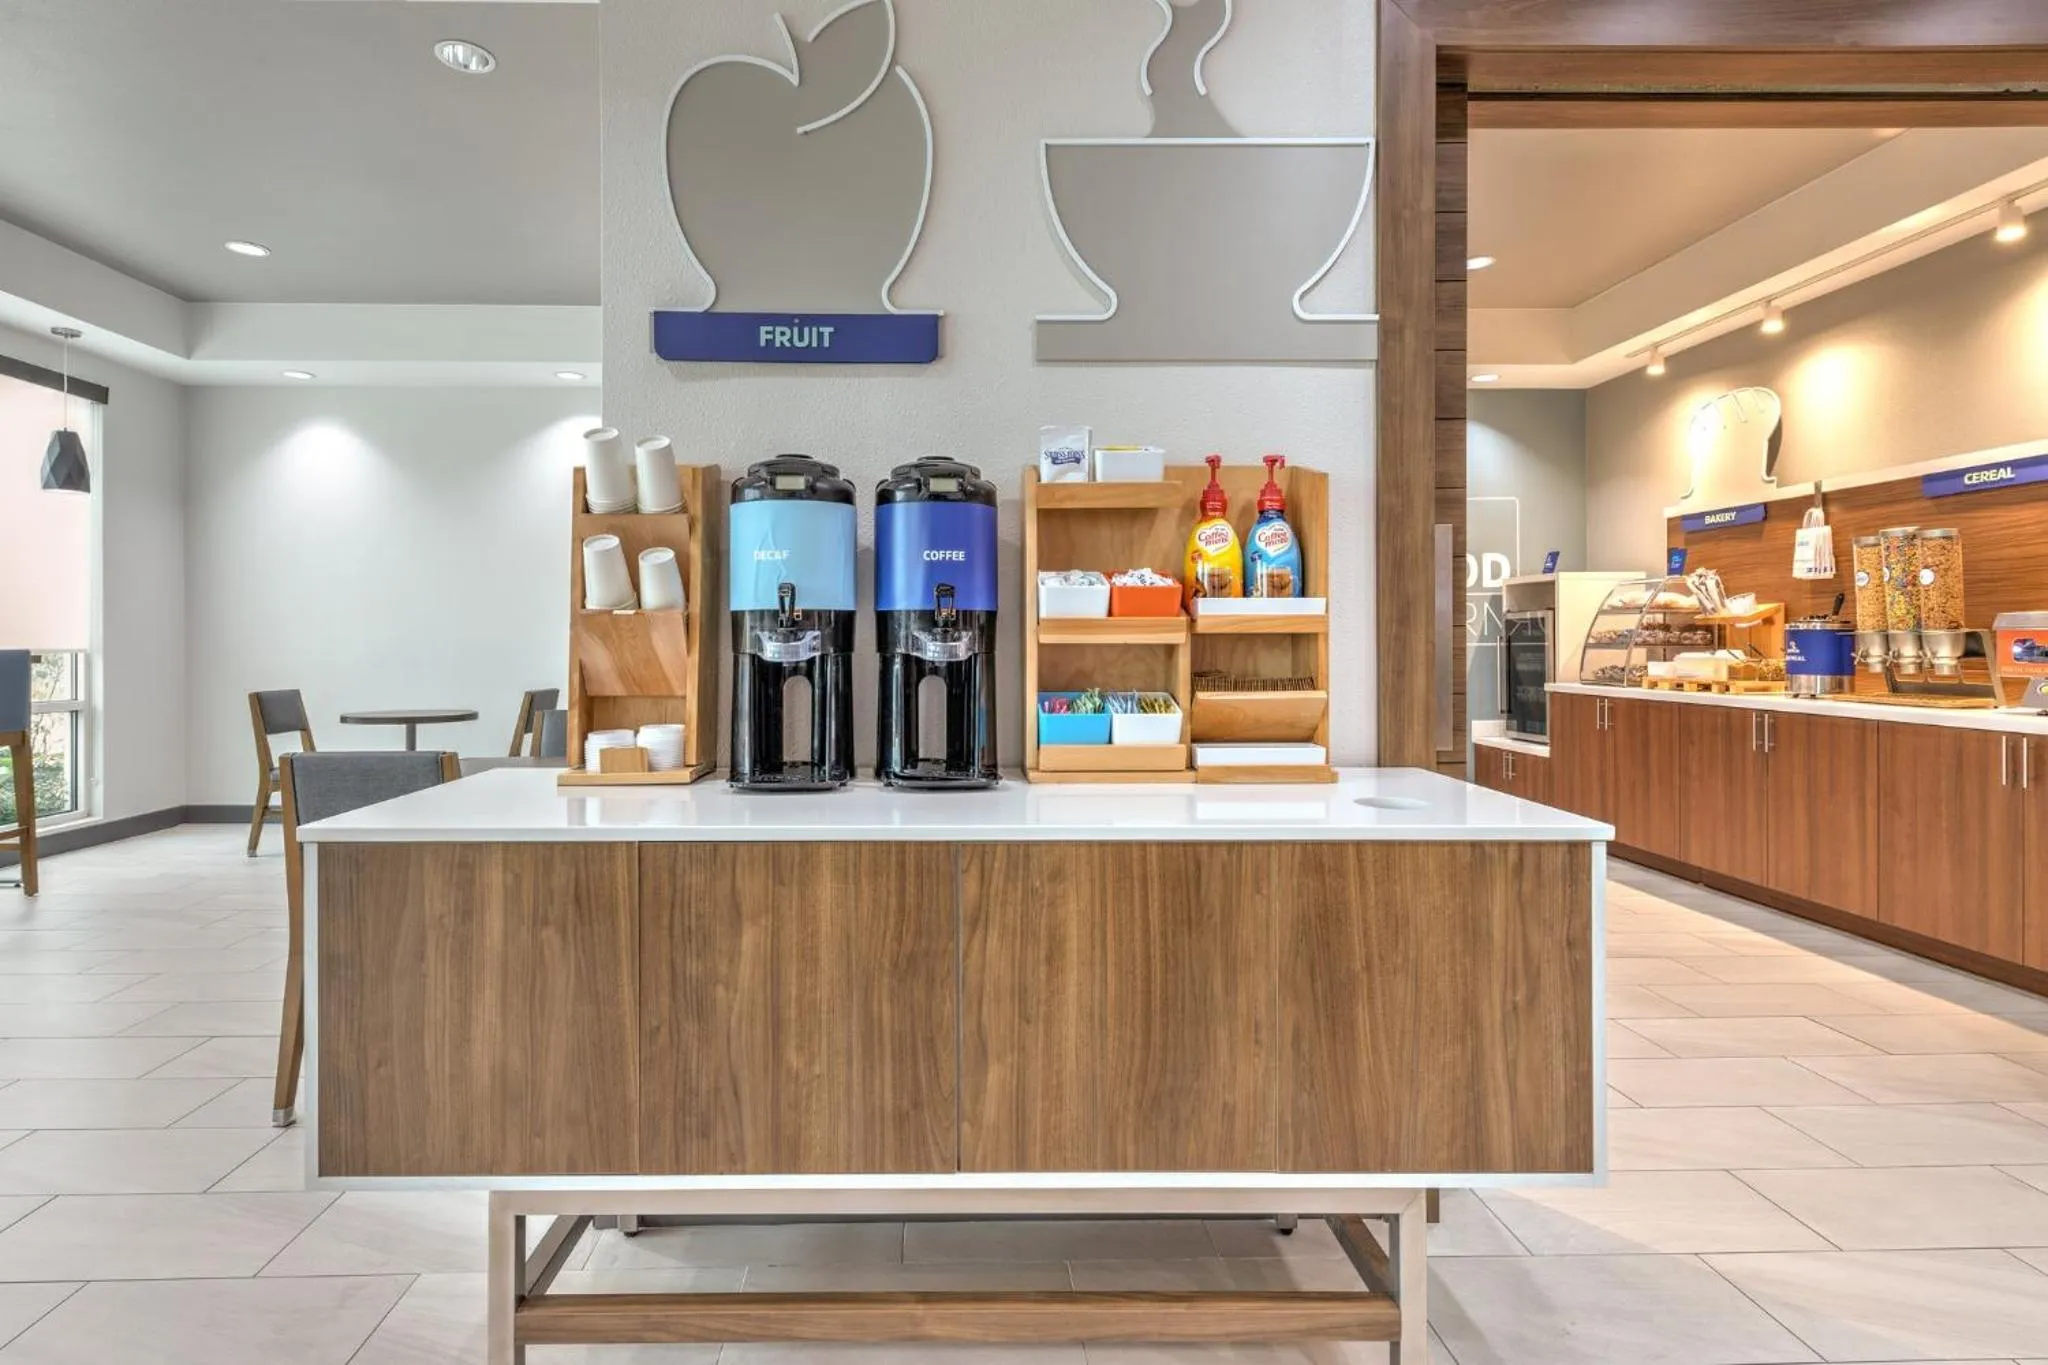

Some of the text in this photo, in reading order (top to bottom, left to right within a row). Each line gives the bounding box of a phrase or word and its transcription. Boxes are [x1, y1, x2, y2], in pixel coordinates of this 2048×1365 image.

[760, 325, 834, 347] FRUIT
[1964, 466, 2016, 484] CEREAL
[1704, 511, 1737, 525] BAKERY
[753, 550, 791, 560] DECAF
[923, 550, 965, 560] COFFEE
